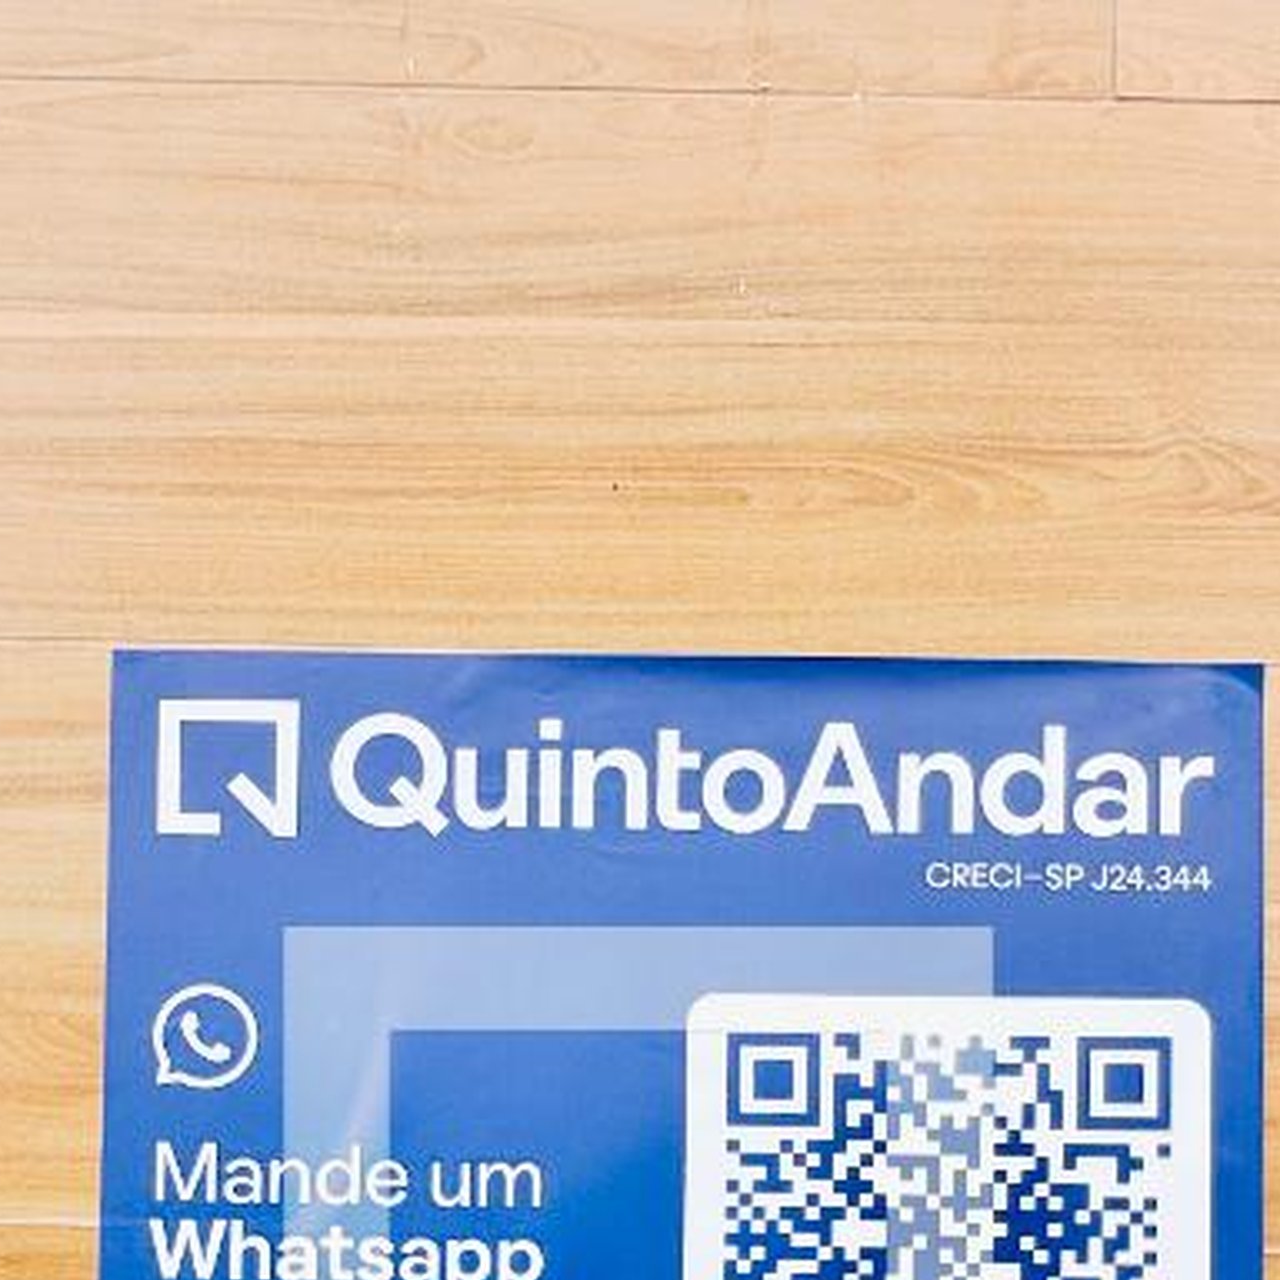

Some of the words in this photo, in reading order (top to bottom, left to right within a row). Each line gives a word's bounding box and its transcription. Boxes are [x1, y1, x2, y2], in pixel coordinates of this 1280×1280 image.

[330, 712, 1215, 838] QuintoAndar
[924, 862, 1084, 891] CRECI-SP
[1090, 865, 1213, 892] J24.344
[153, 1140, 409, 1206] Mande
[430, 1158, 544, 1208] um
